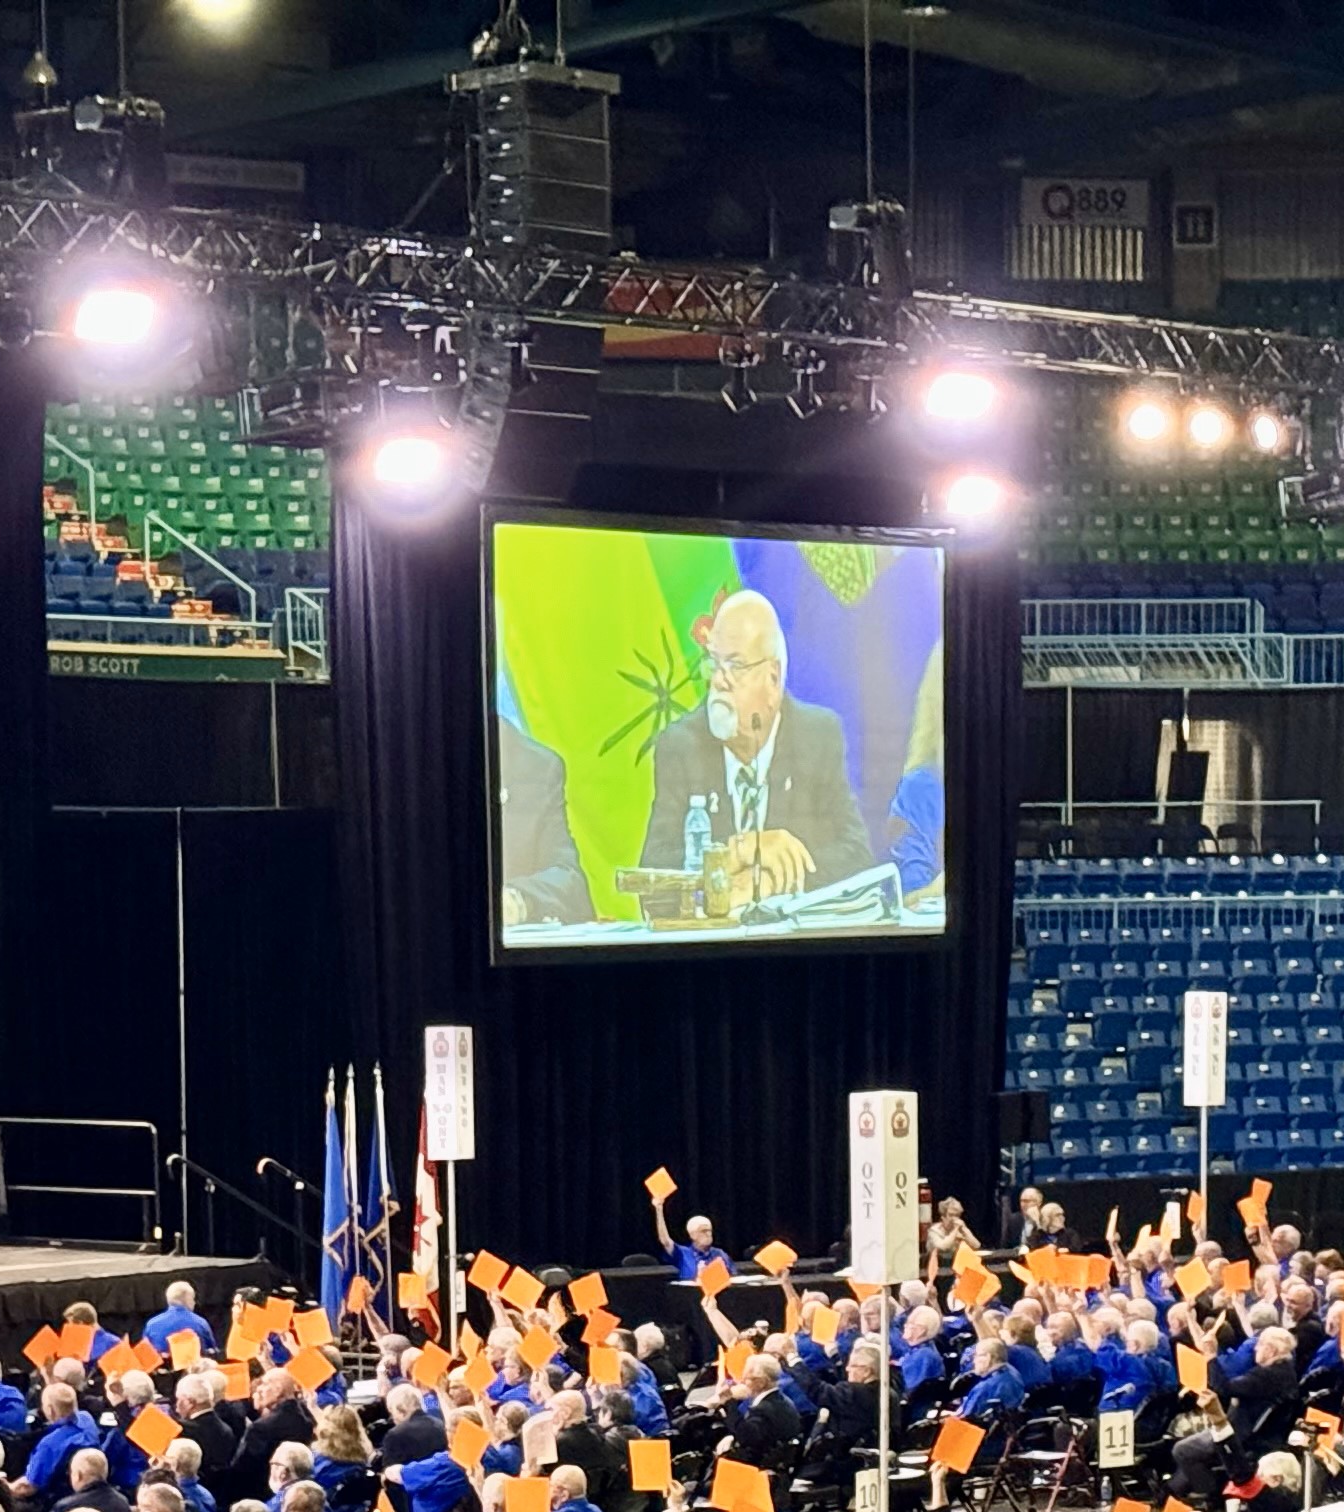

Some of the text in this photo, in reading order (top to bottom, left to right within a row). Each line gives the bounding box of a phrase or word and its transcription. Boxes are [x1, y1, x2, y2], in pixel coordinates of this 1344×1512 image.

[49, 656, 140, 675] ROB SCOTT
[862, 1162, 874, 1219] ONT
[895, 1171, 907, 1209] ON
[1104, 1424, 1129, 1449] 11
[859, 1483, 877, 1508] 10
